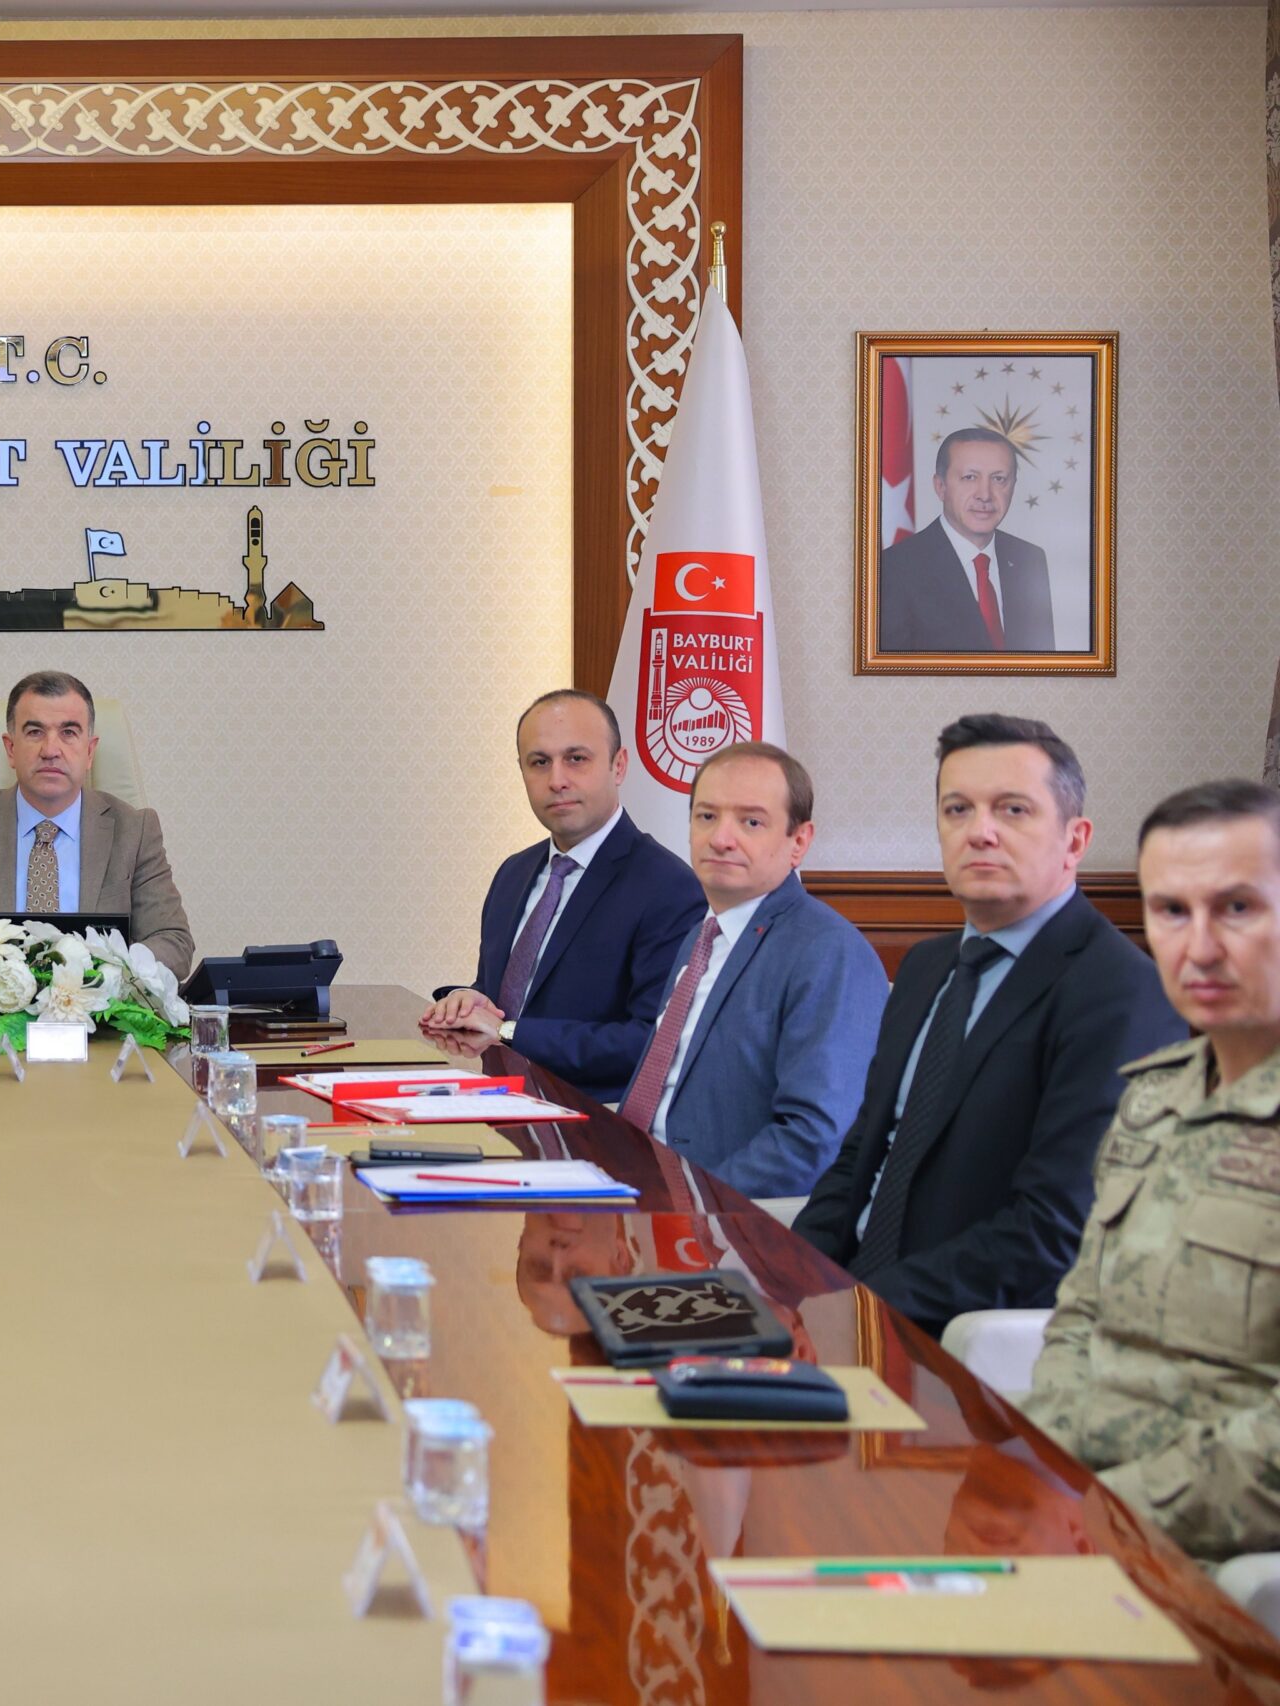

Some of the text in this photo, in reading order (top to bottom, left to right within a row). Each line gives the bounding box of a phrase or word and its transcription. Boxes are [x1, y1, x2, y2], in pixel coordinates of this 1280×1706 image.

[55, 418, 377, 488] VALİLİĞİ
[673, 633, 754, 652] BAYBURT
[671, 652, 753, 673] VALİLİĞİ
[685, 735, 715, 747] 1989
